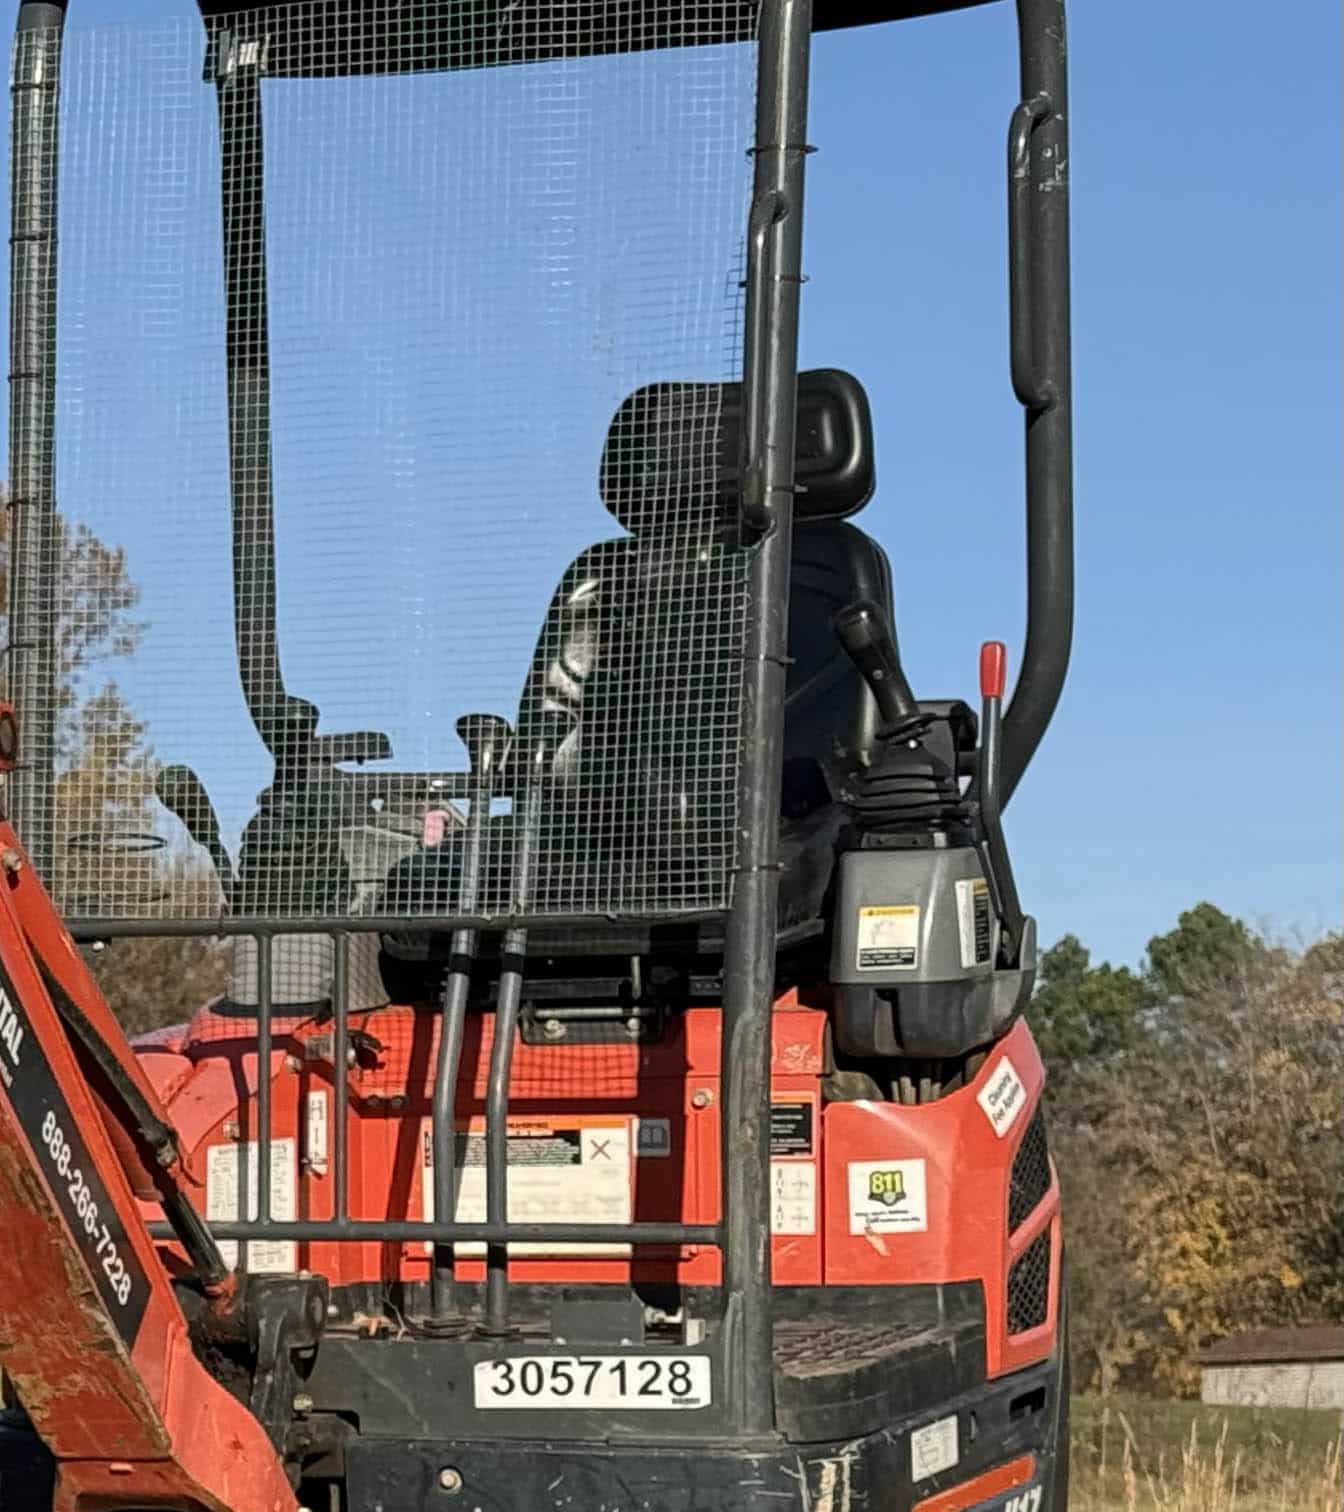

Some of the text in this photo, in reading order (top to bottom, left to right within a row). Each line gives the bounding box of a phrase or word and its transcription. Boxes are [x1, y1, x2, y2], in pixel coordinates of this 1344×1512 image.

[870, 1172, 904, 1194] 811
[42, 1110, 131, 1306] 888-266-7228
[491, 1360, 693, 1396] 3057128
